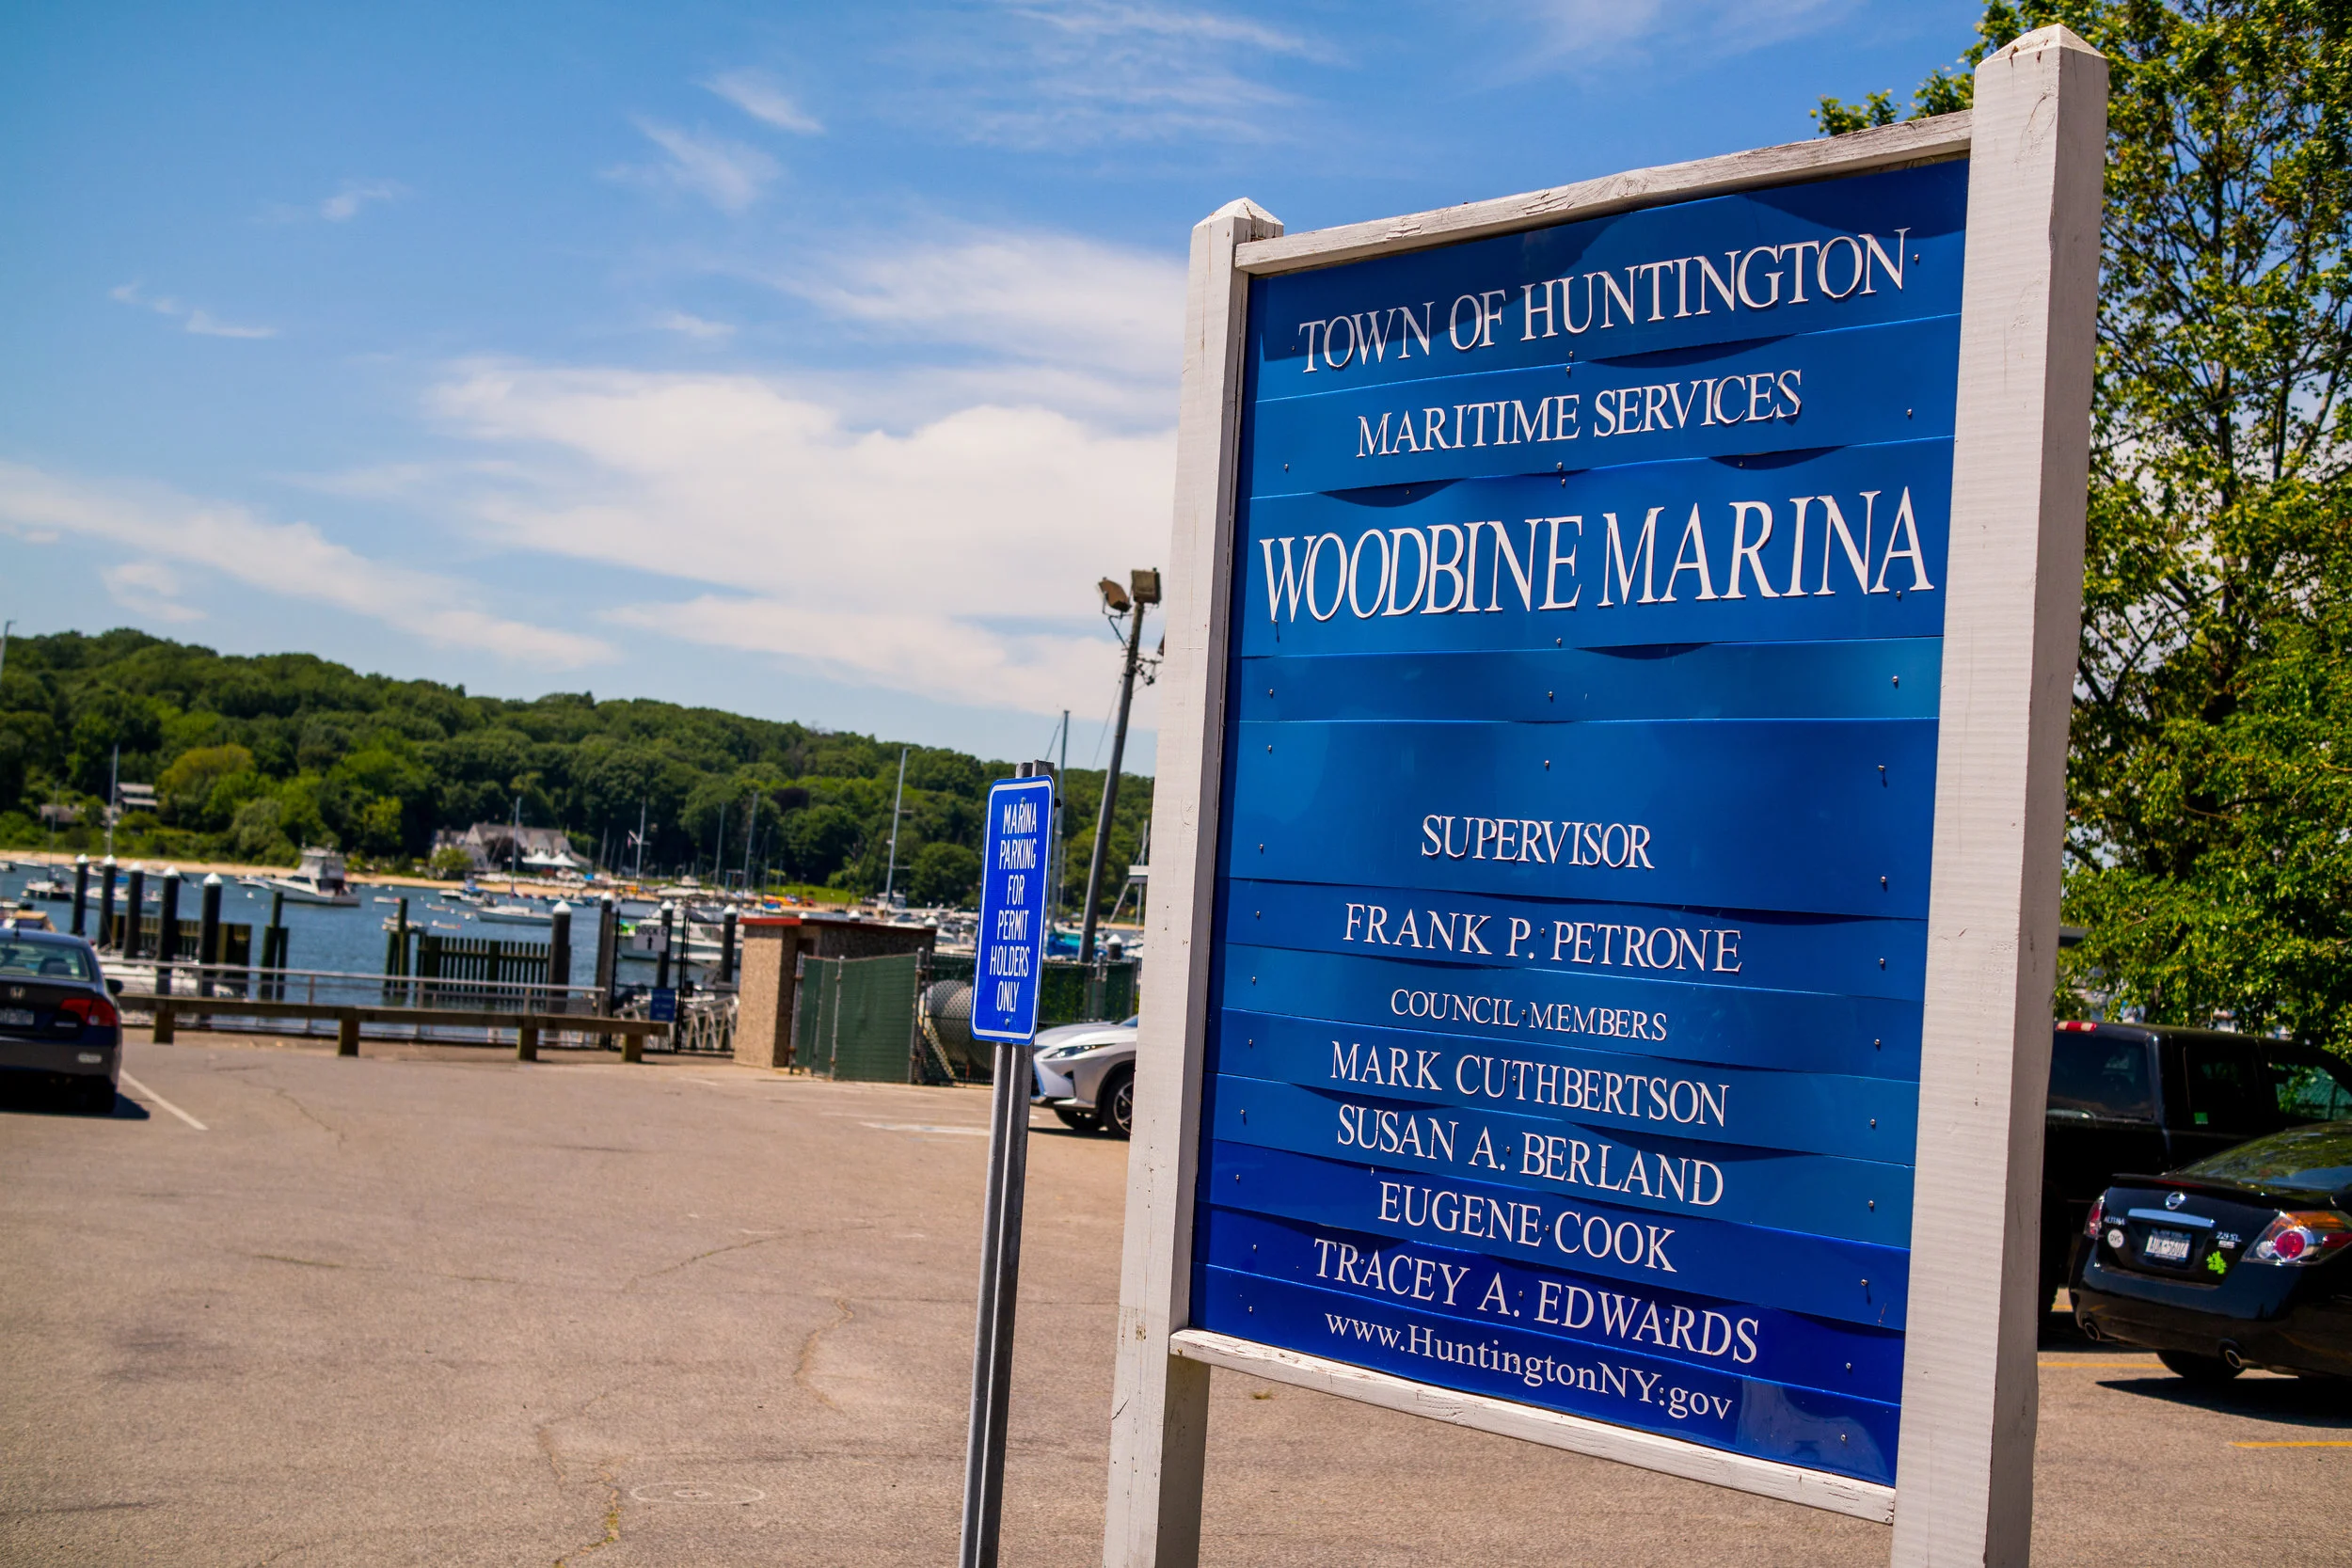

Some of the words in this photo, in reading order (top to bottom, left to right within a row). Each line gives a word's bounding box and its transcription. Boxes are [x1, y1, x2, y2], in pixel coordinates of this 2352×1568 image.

[1298, 302, 1435, 373] TOWN
[1449, 289, 1506, 351] OF
[1519, 227, 1911, 341] HUNTINGTON
[1356, 393, 1581, 458] MARITIME
[1594, 370, 1802, 437] SERVICES
[1259, 515, 1582, 623] WOODBINE
[1597, 485, 1935, 607] MARINA
[1003, 802, 1037, 834] MARINA
[1421, 814, 1655, 869] SUPERVISOR
[999, 838, 1037, 870] PARKING
[997, 910, 1029, 941] PERMIT
[1007, 875, 1025, 906] FOR
[990, 945, 1030, 977] HOLDERS
[1343, 903, 1493, 955] FRANK
[1505, 917, 1534, 959] P.
[1549, 921, 1742, 973] PETRONE
[996, 981, 1020, 1012] ONLY
[1391, 989, 1519, 1027] COUNCIL
[1528, 1002, 1667, 1041] MEMBERS
[1329, 1040, 1442, 1091] MARK
[1455, 1055, 1730, 1127] CUTHBERTSON
[1337, 1103, 1459, 1163] SUSAN
[1468, 1126, 1506, 1171] A.
[1519, 1132, 1724, 1206] BERLAND
[1377, 1181, 1542, 1247] EUGENE
[1554, 1211, 1677, 1273] COOK
[1313, 1239, 1470, 1307] TRACEY
[1476, 1272, 1520, 1318] A.
[1534, 1280, 1759, 1364] EDWARDS
[1325, 1313, 1733, 1419] www.HuntingtonNY.gov
